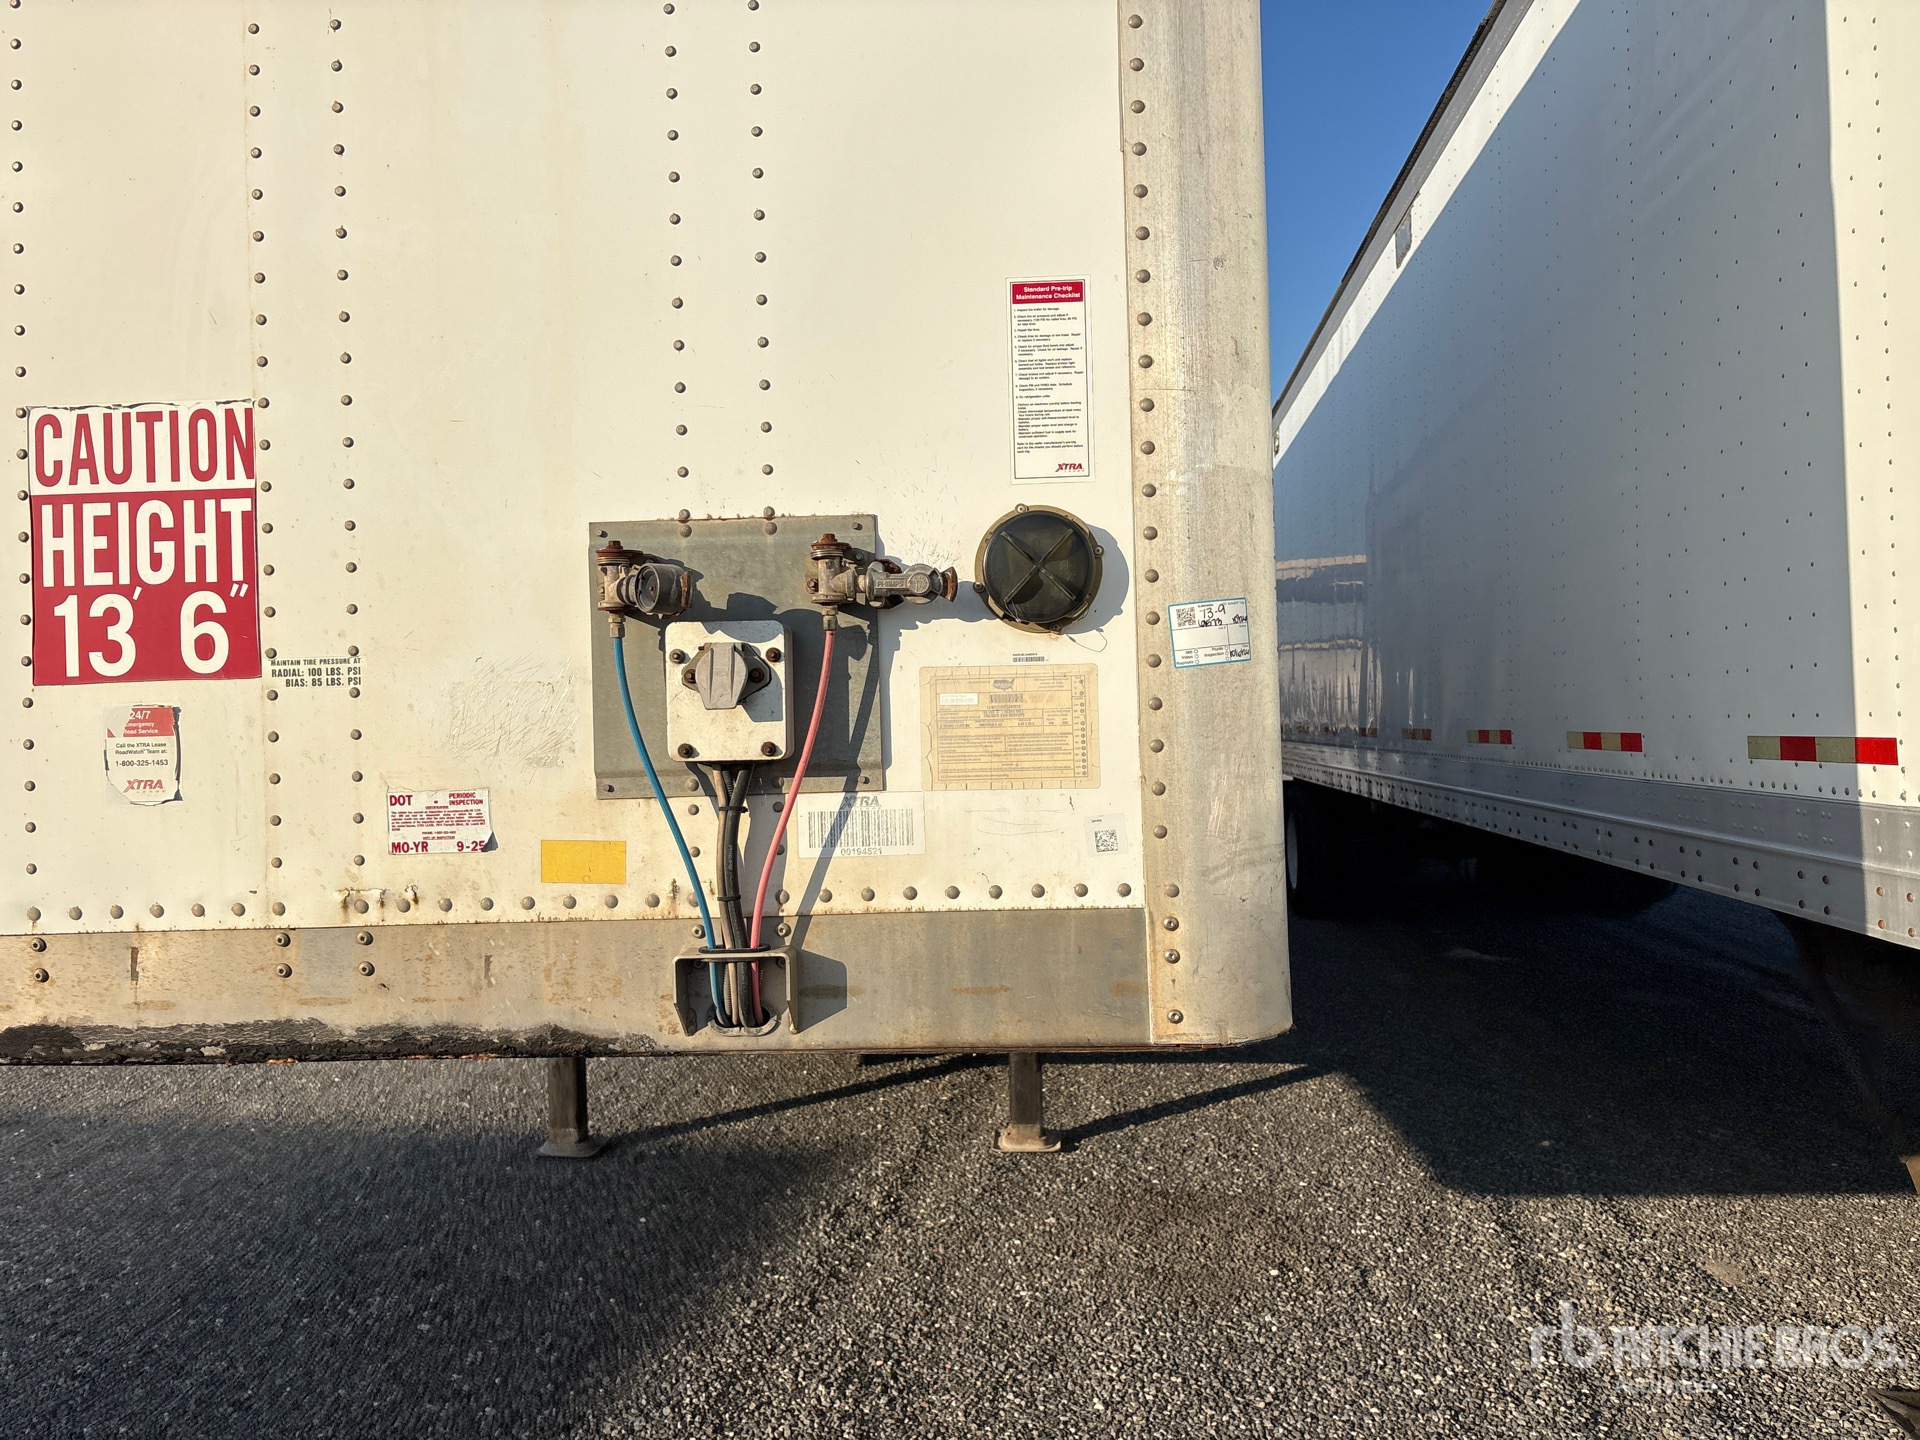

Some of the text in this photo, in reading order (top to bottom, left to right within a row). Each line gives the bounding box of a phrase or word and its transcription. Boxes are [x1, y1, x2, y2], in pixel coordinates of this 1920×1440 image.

[34, 407, 255, 488] CAUTION
[1055, 463, 1083, 472] XTRA
[41, 497, 252, 587] HEIGHT
[272, 667, 361, 677] RADIAL: 100 LBS. PSI
[286, 677, 361, 687] BIAS: 85 LBS. PSI
[130, 710, 150, 719] 24/7
[123, 779, 164, 793] XTRA
[390, 795, 413, 806] DOT
[840, 796, 880, 809] XTRA
[392, 841, 428, 853] MO-YR
[841, 848, 882, 856] 00194521
